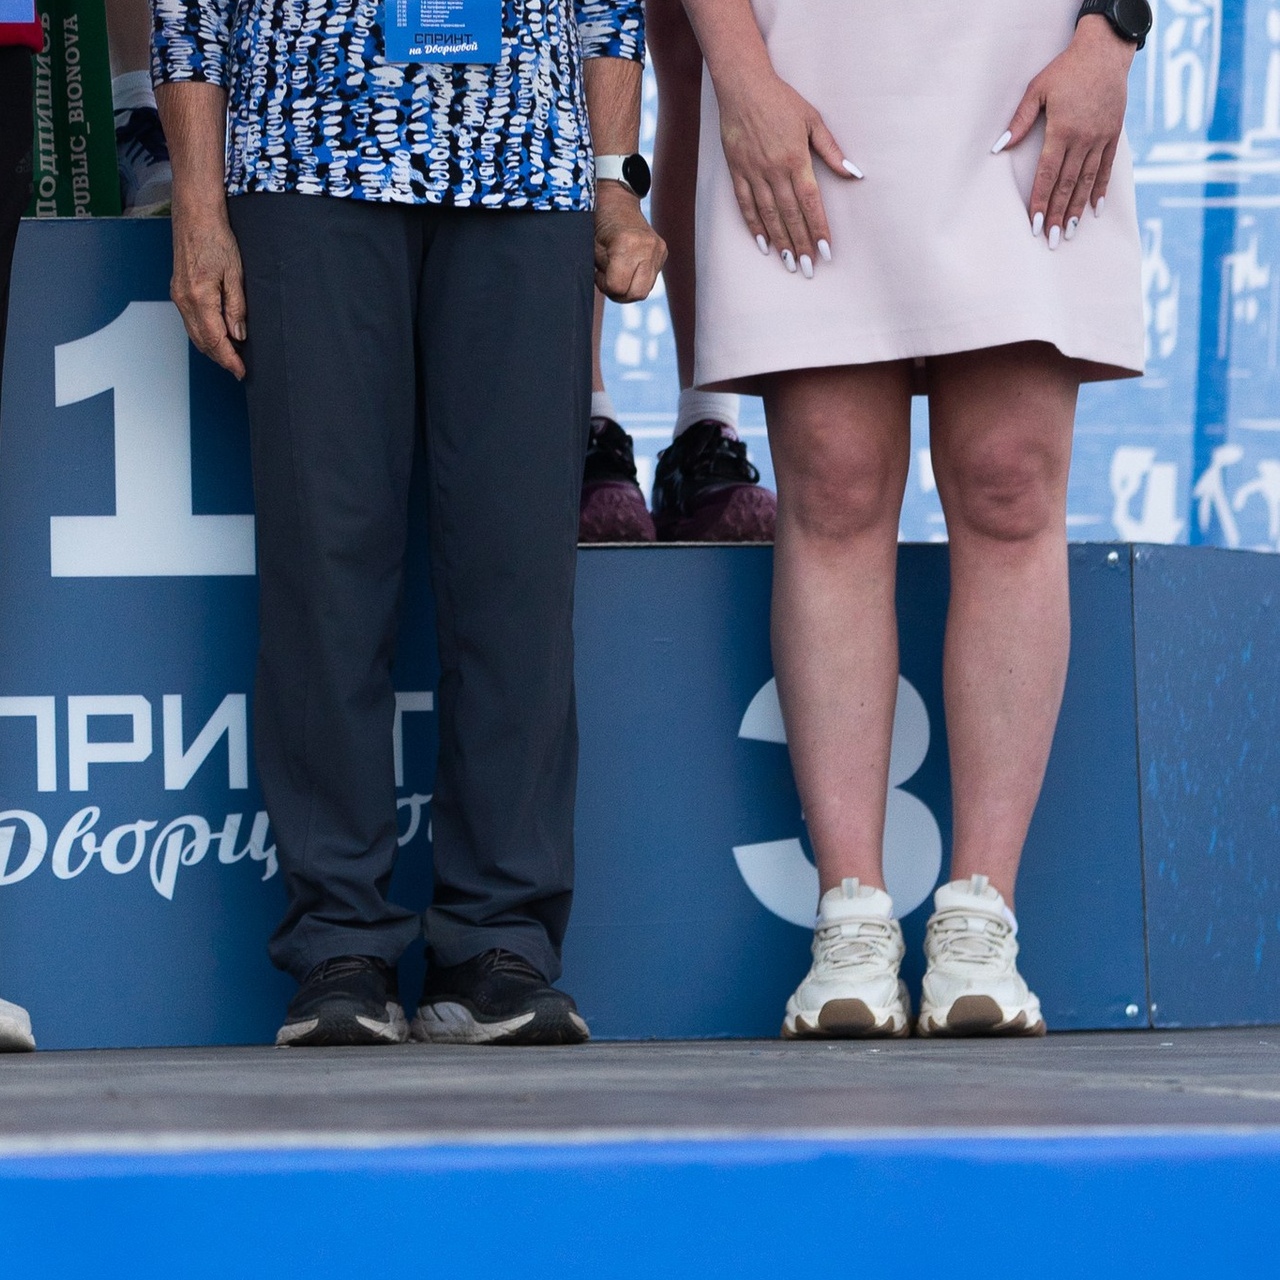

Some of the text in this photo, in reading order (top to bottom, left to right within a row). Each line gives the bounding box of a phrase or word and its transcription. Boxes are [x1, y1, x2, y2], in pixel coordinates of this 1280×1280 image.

[409, 41, 479, 56] на Дворцовой
[414, 33, 474, 45] СПРИНТ
[50, 300, 256, 577] 1
[732, 671, 943, 930] 3
